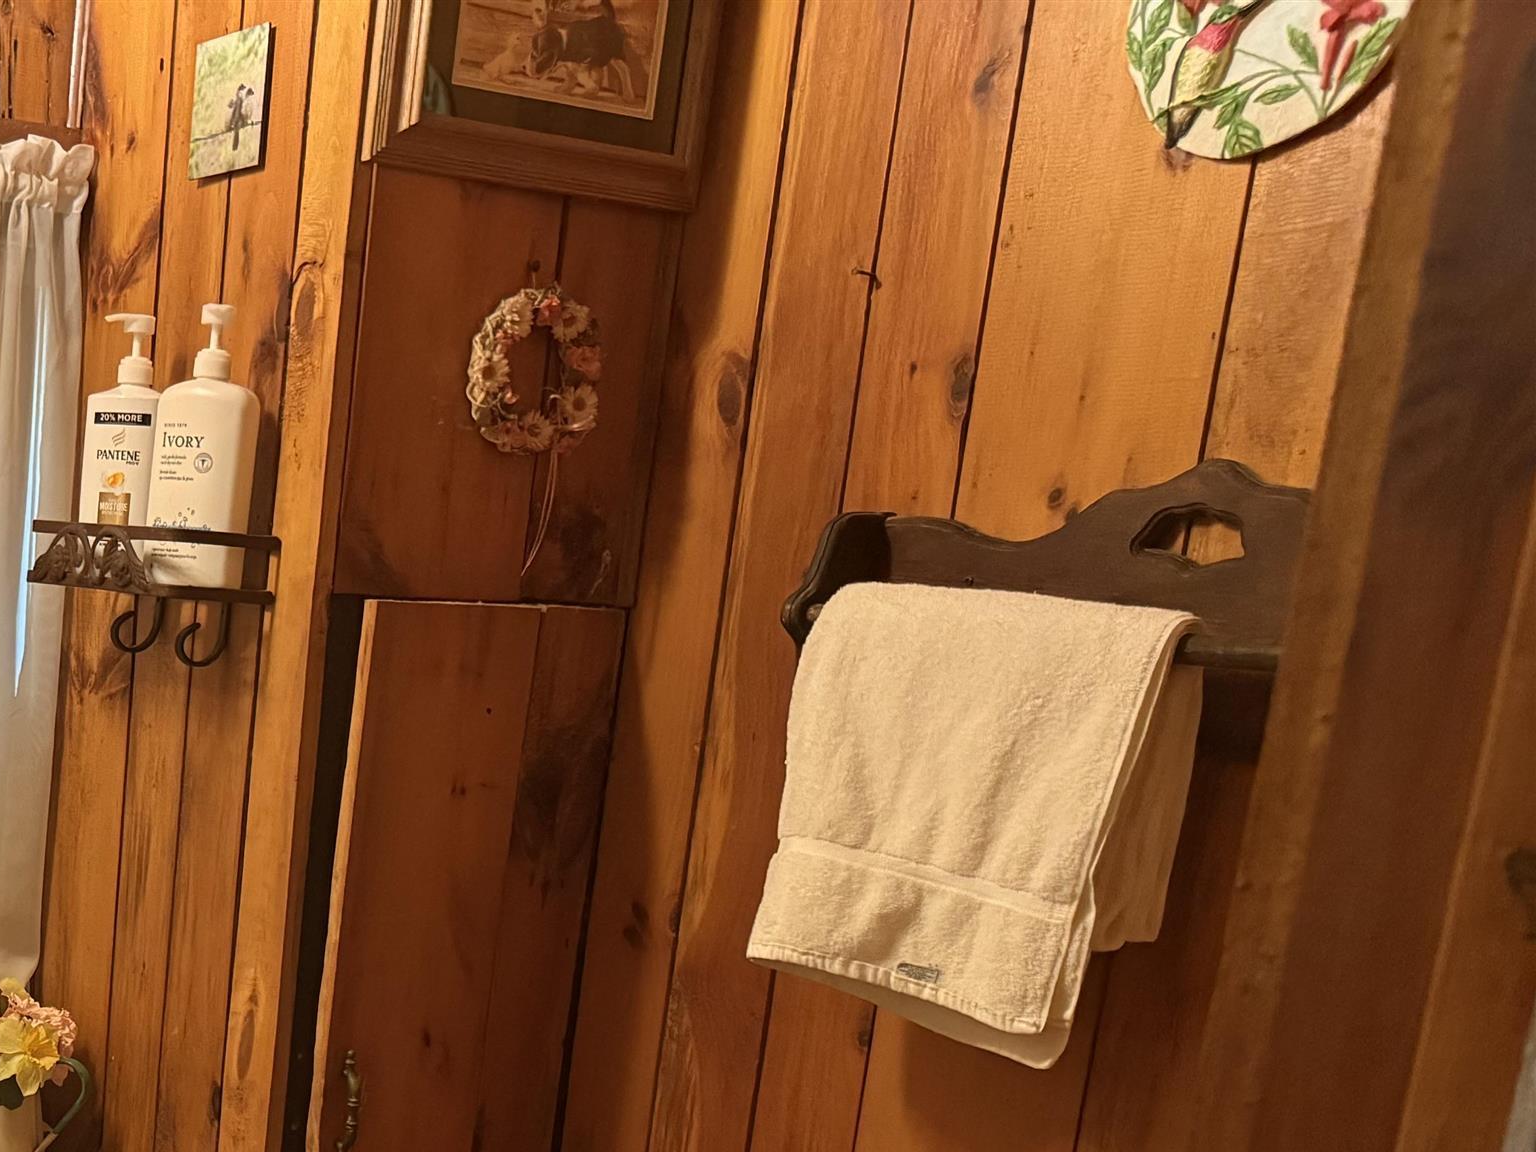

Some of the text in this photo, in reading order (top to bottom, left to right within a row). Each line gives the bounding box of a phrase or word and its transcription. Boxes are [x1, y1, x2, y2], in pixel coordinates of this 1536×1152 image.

[100, 413, 143, 423] 20% MORE
[96, 449, 141, 462] PANTENE
